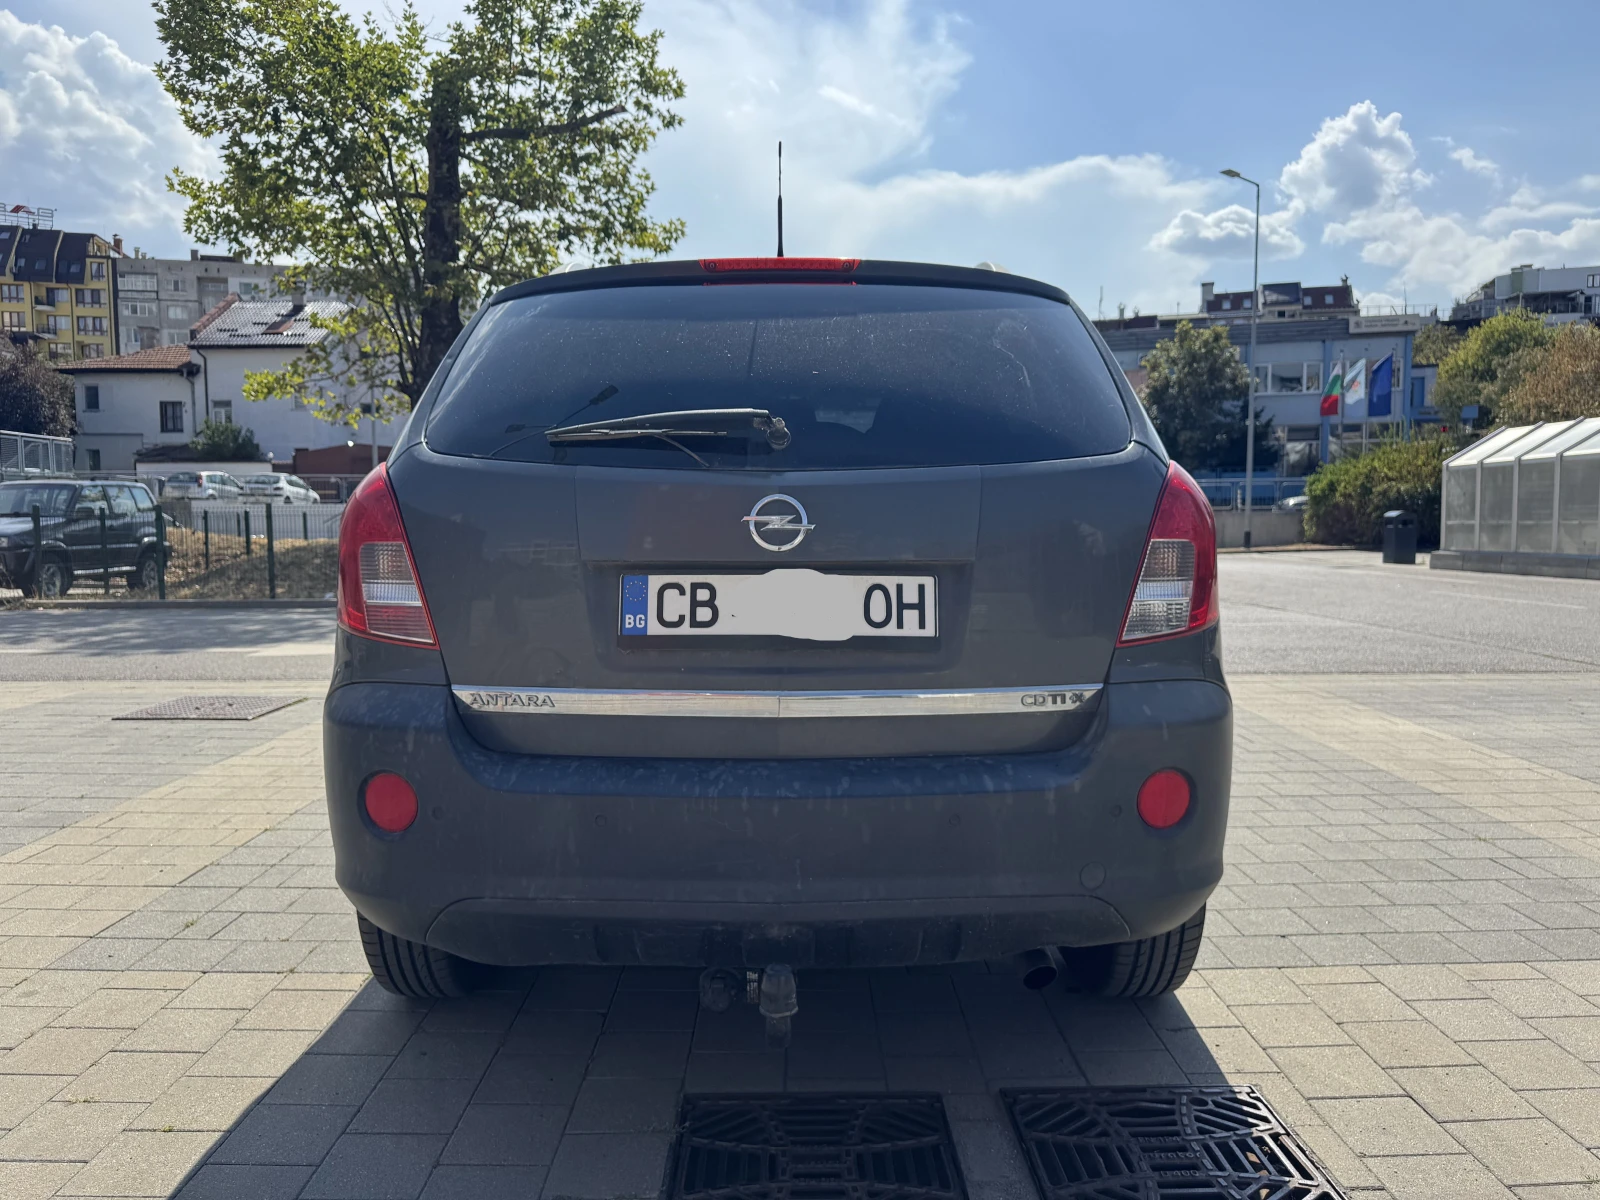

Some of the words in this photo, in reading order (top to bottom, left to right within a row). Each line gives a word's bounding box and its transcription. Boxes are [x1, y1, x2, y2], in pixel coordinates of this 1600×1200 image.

[656, 581, 719, 629] CB
[863, 582, 926, 630] OH
[625, 614, 646, 628] BG
[470, 692, 555, 708] ANTARA
[1021, 693, 1067, 706] CDTI
